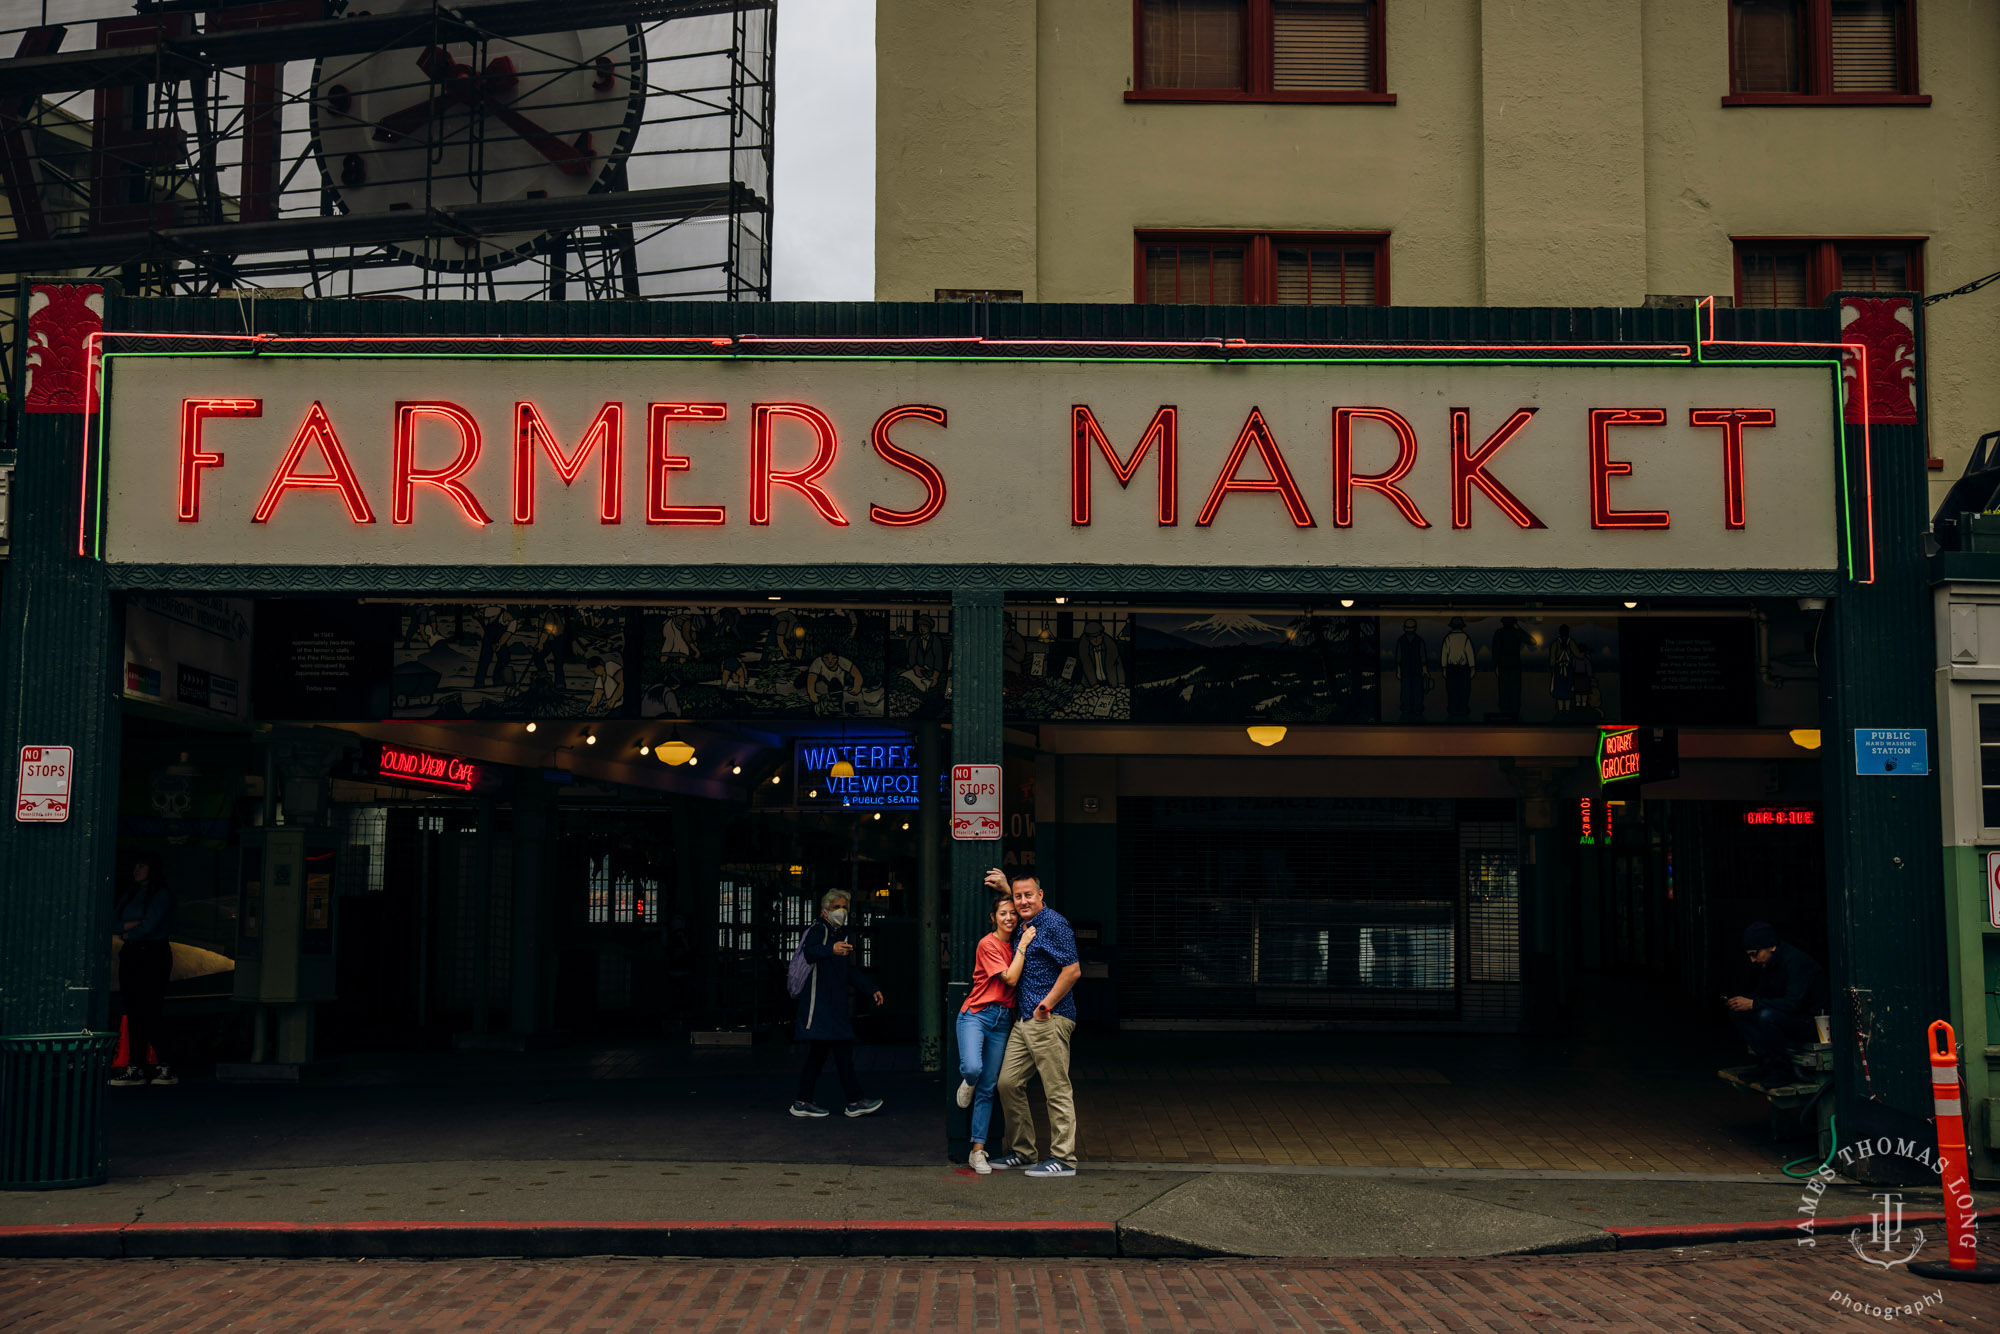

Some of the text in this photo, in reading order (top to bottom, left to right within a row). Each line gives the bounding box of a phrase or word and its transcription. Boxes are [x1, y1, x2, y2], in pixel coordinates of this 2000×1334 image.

[178, 398, 1777, 531] FARMERS MARKET
[1871, 731, 1911, 740] PUBLIC
[1606, 732, 1634, 754] ROTARY
[25, 750, 39, 760] NO
[419, 752, 447, 777] VIEW
[1602, 753, 1640, 779] GROCERY
[27, 765, 65, 777] STOPS
[955, 768, 969, 779] NO
[959, 783, 995, 795] STOPS
[852, 796, 885, 805] PUBLIC
